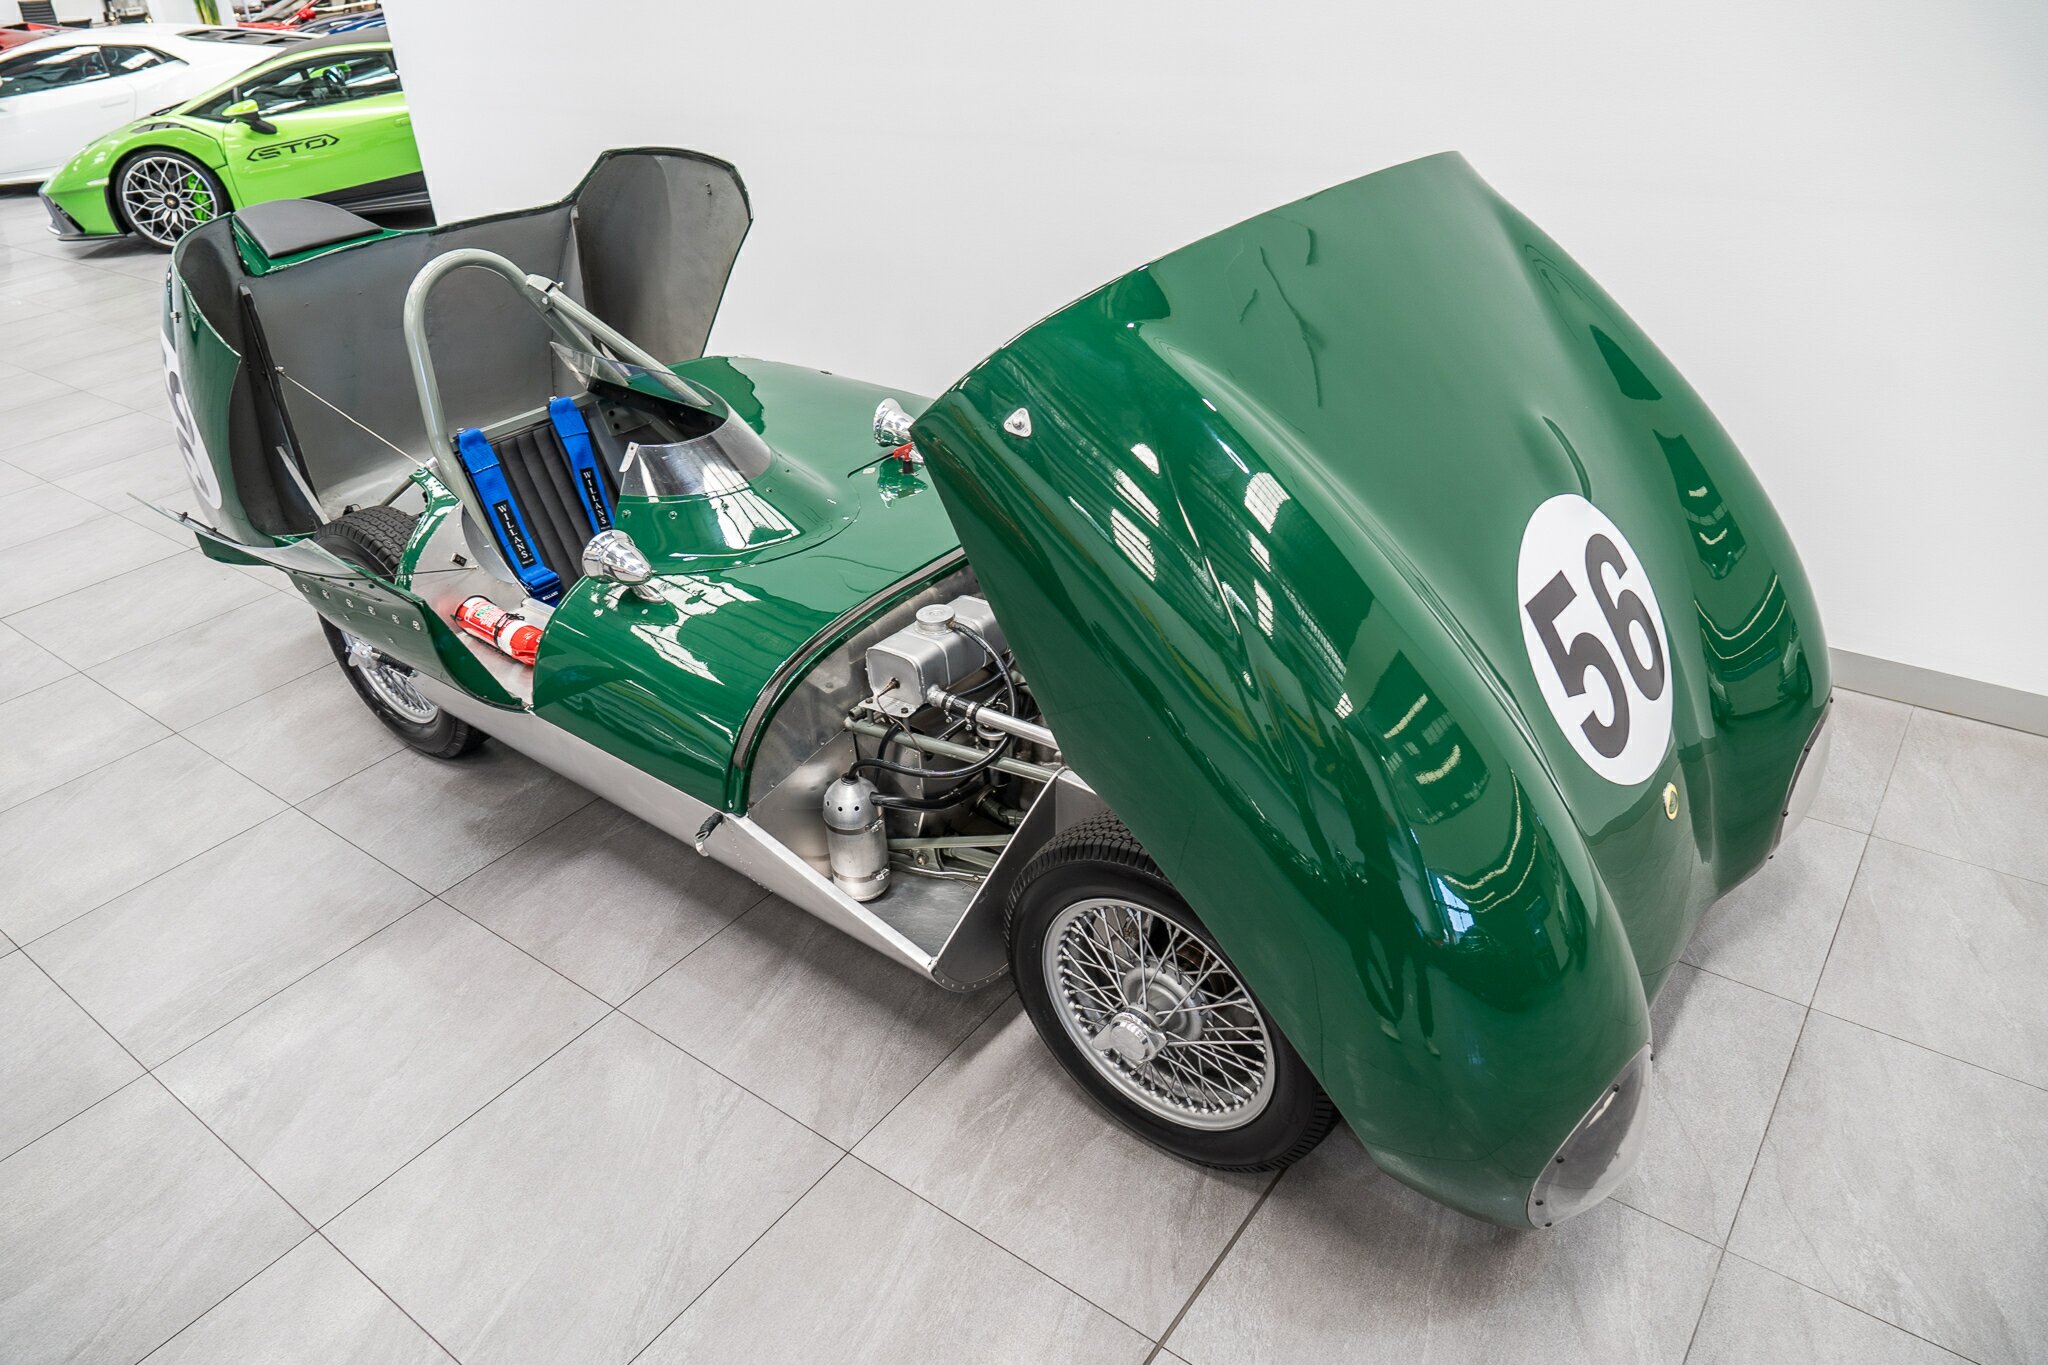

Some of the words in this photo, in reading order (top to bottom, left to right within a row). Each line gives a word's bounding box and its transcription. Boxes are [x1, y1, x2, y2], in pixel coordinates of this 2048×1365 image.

[257, 137, 328, 159] STO
[583, 471, 607, 524] WILLANS
[497, 504, 528, 559] WILLANS
[1525, 533, 1665, 759] 56
